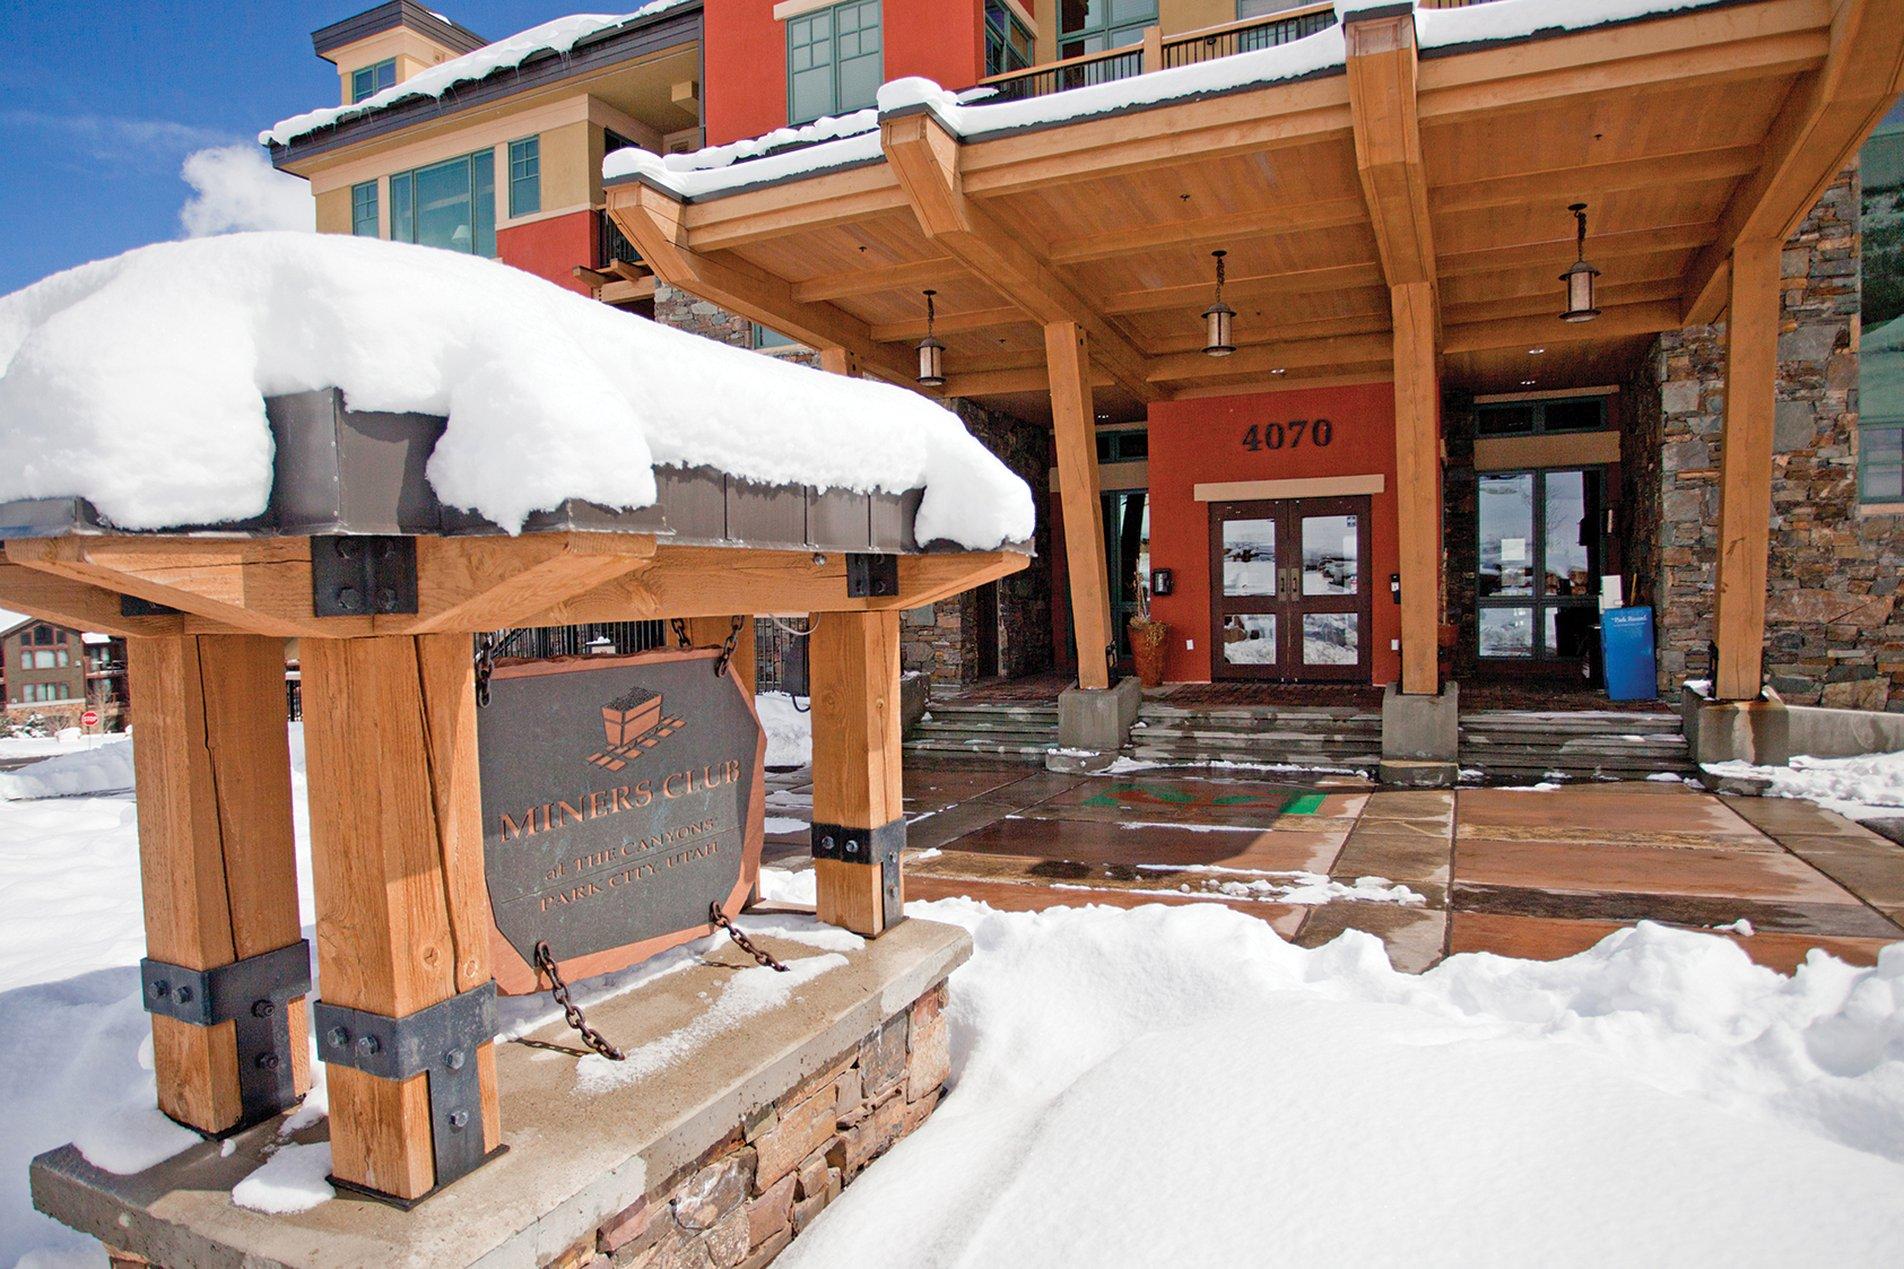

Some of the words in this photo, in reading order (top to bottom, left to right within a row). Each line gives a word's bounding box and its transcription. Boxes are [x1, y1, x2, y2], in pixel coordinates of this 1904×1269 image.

[1242, 419, 1333, 452] 4070
[499, 780, 654, 844] MINERS
[661, 759, 741, 799] CLUB
[540, 882, 603, 912] PARK
[666, 841, 719, 868] UTAH
[545, 862, 567, 882] at
[573, 847, 618, 872] THE
[620, 818, 715, 857] CANYONS
